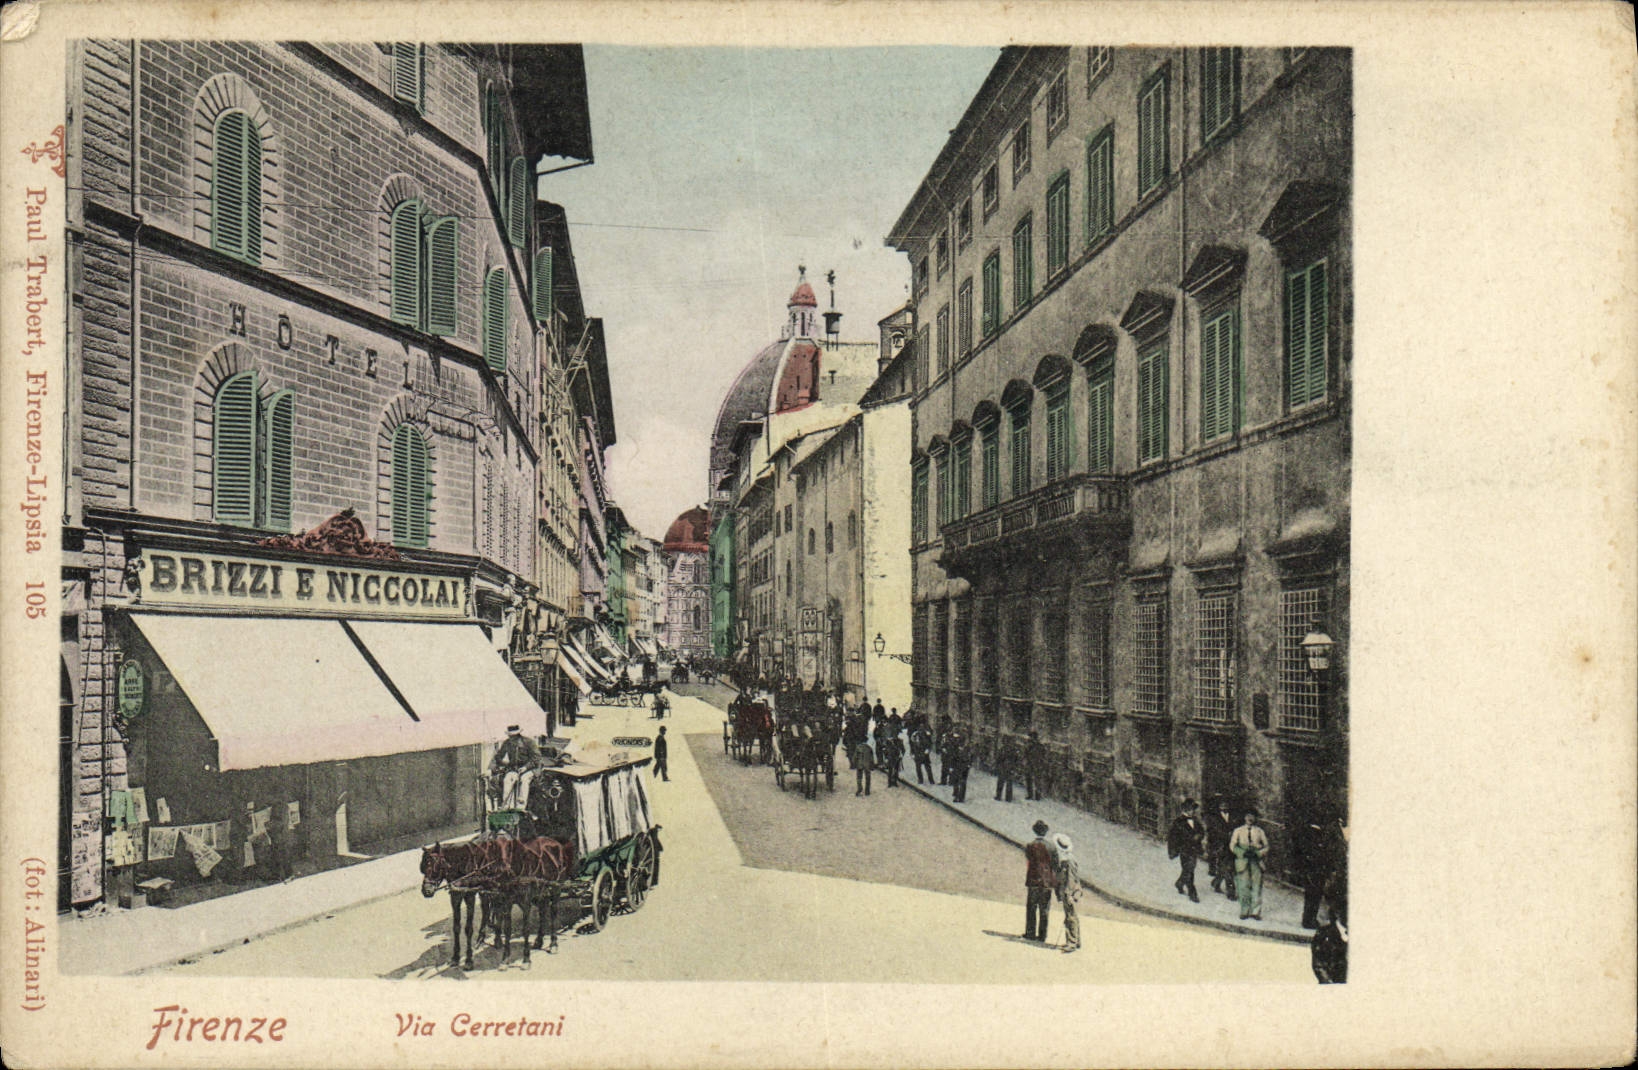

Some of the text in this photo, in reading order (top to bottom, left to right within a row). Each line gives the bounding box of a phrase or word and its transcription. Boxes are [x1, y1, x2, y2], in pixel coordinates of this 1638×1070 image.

[150, 554, 460, 608] BRIZZI E NICCOLAI
